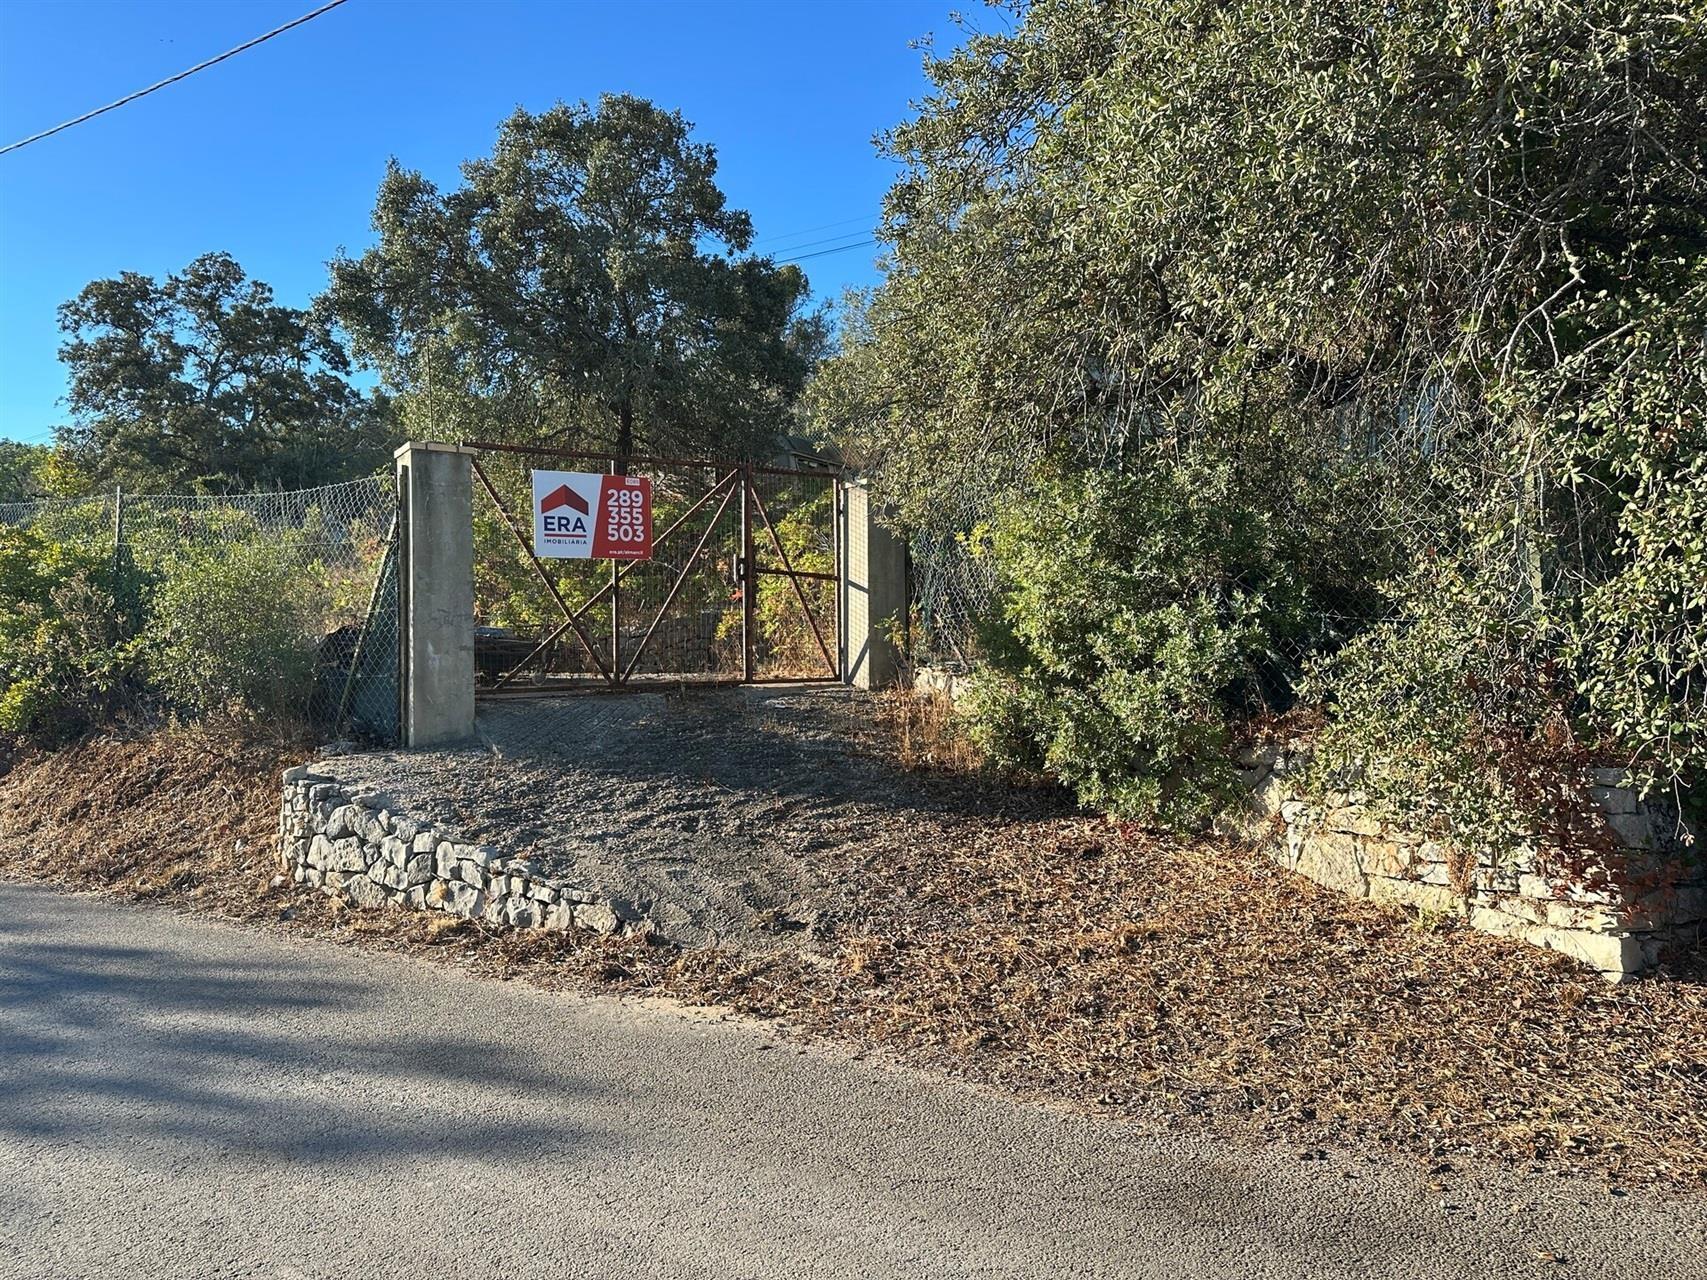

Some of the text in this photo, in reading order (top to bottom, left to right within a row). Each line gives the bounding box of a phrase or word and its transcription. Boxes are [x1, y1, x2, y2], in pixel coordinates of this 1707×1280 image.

[607, 488, 643, 508] 289
[544, 516, 587, 532] ERA
[607, 507, 643, 525] 355
[607, 524, 645, 542] 503
